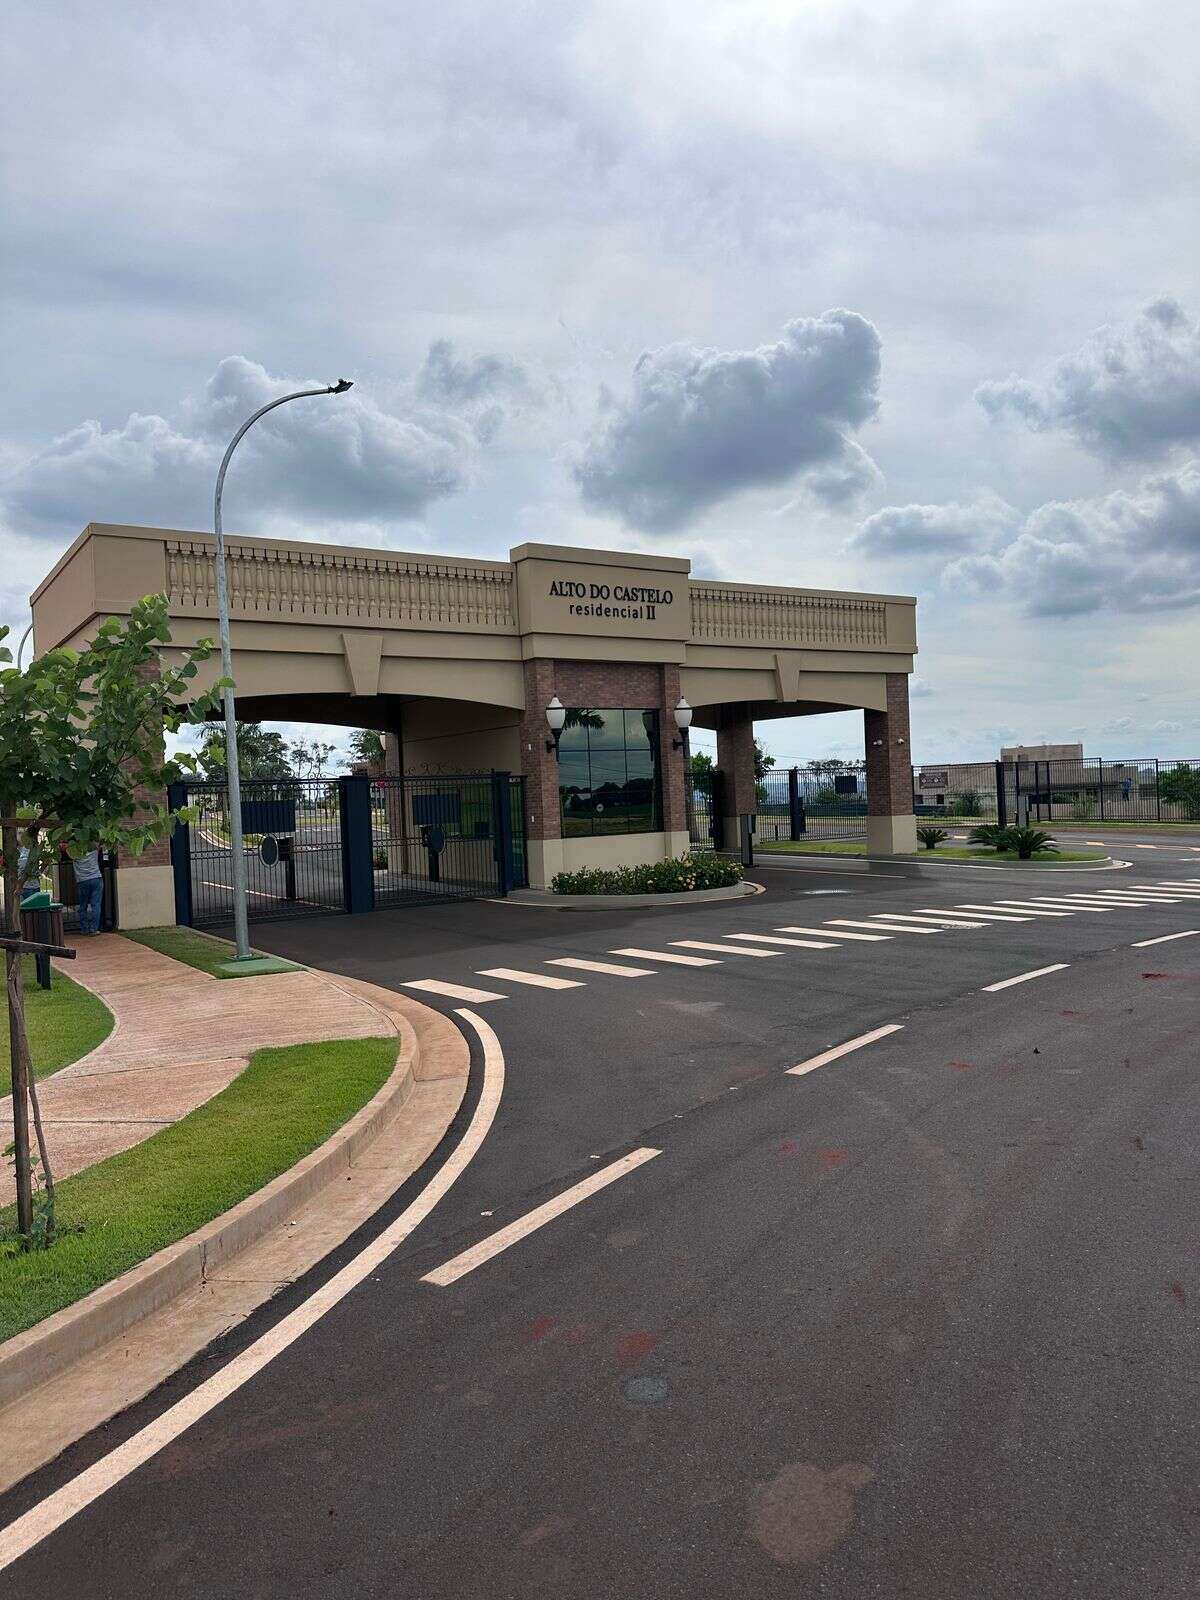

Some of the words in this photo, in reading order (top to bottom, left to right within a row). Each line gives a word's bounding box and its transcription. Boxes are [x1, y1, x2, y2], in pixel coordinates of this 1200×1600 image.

[549, 581, 586, 598] ALTO
[590, 584, 610, 600] DO
[613, 586, 673, 604] CASTELO
[569, 603, 643, 619] residencial
[646, 605, 656, 620] II
